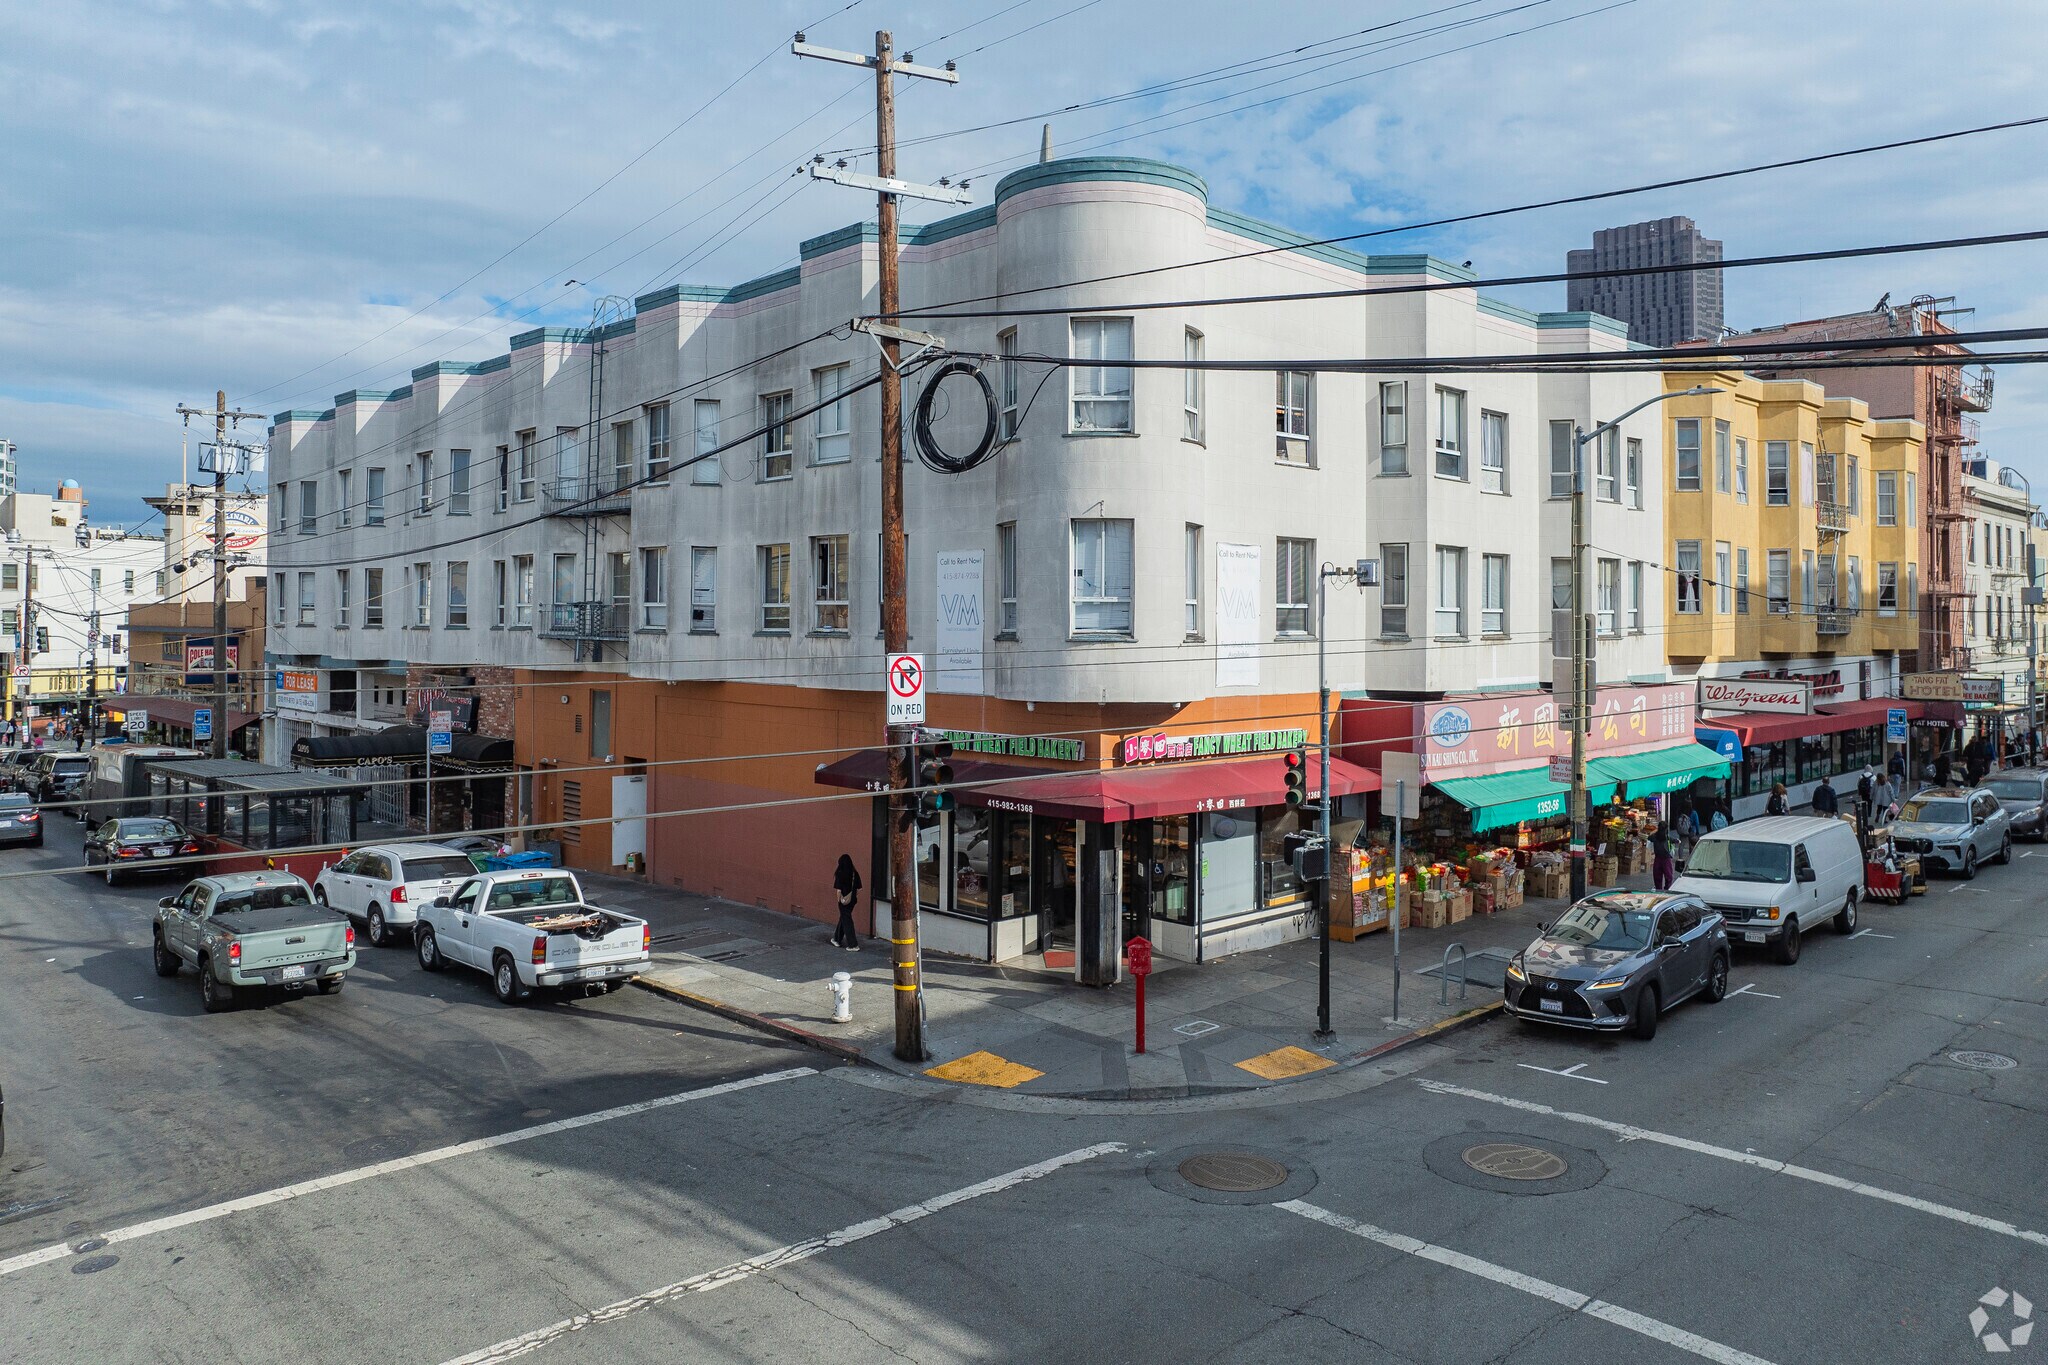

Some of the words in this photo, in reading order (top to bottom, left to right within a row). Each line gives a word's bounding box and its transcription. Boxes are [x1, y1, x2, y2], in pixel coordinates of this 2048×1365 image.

[1219, 549, 1229, 558] Call
[940, 558, 950, 566] Call
[941, 593, 980, 626] VM
[1220, 586, 1256, 619] VM
[189, 649, 203, 663] COLE
[286, 675, 296, 688] FOR
[297, 676, 315, 690] LEASE
[1913, 676, 1934, 684] TANG
[1935, 675, 1949, 684] FAT
[1705, 684, 1802, 707] Walgreens
[1909, 686, 1961, 697] HOTEL
[890, 704, 903, 716] ON
[905, 703, 922, 715] RED
[130, 721, 146, 729] 20
[1010, 736, 1036, 757] FIELD
[1037, 738, 1079, 761] BAKERY
[1193, 735, 1221, 756] FANCY
[1222, 733, 1252, 754] WHEAT
[1253, 732, 1276, 751] FIELD
[1276, 730, 1307, 749] BAKERY
[357, 757, 393, 765] CAPO'S
[1432, 753, 1442, 767] KAU
[1443, 751, 1458, 766] SHING
[1469, 749, 1479, 763] INC.
[987, 799, 1033, 813] 415-982-1368
[1536, 799, 1560, 815] 1352-56
[551, 939, 639, 957] CHEVROLET
[266, 951, 326, 962] TACOMA
